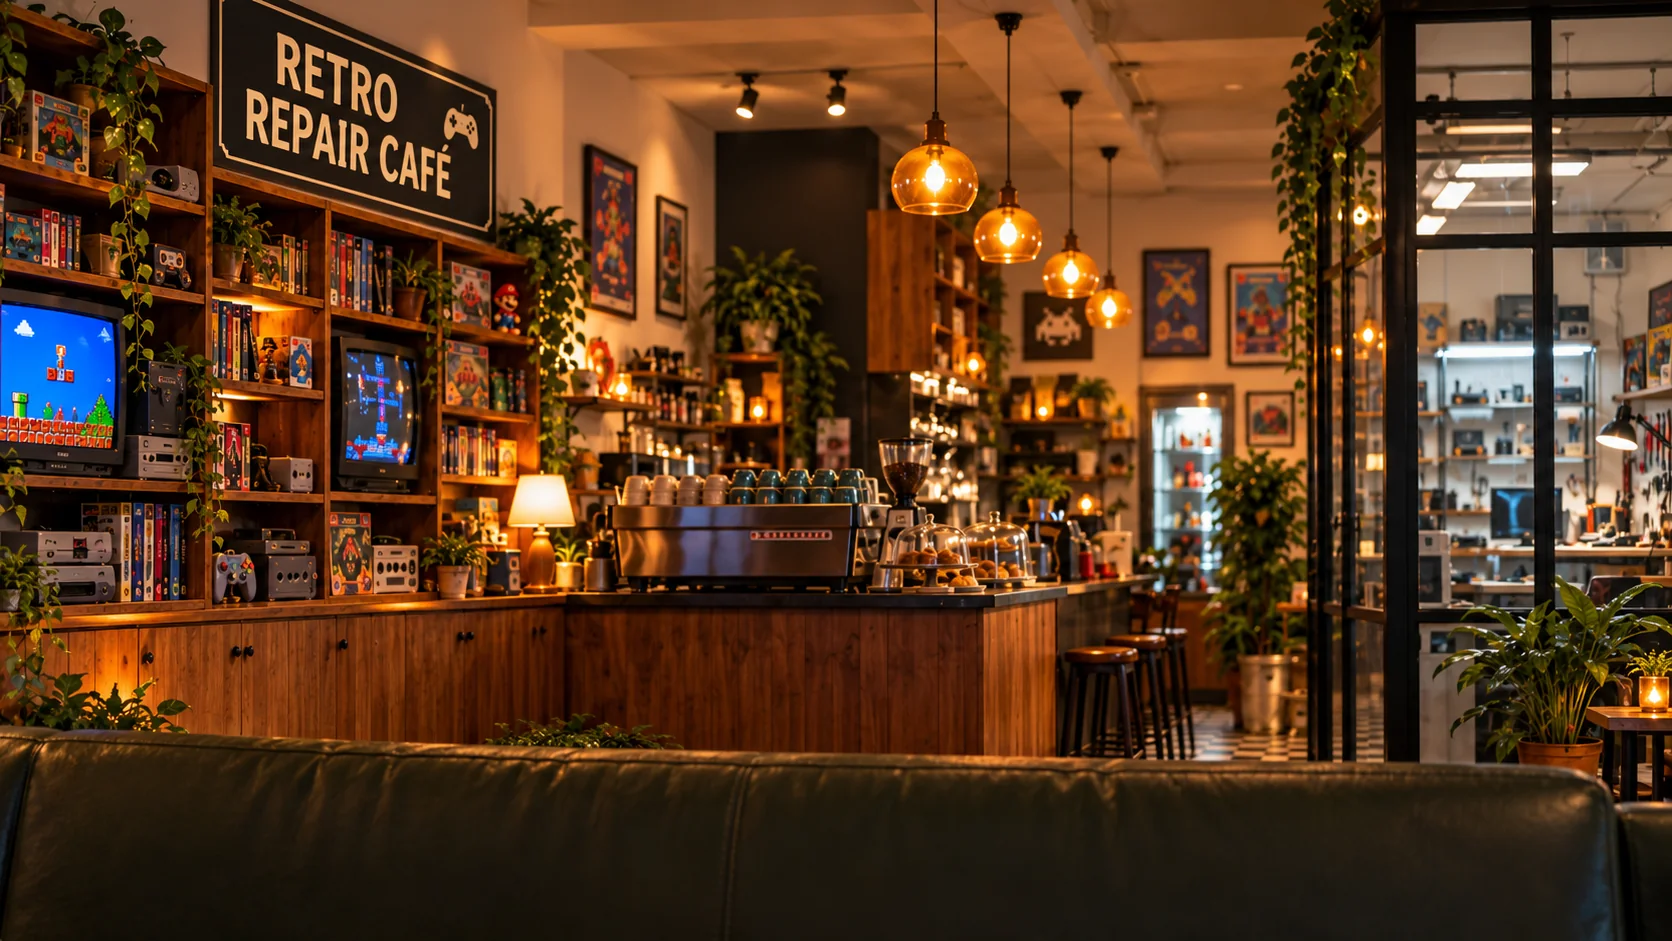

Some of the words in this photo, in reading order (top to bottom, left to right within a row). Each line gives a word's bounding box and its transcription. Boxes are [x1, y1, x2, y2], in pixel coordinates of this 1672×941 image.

[276, 31, 398, 123] RETRO
[245, 87, 370, 175] REPAIR
[379, 134, 452, 200] CAFÉ
